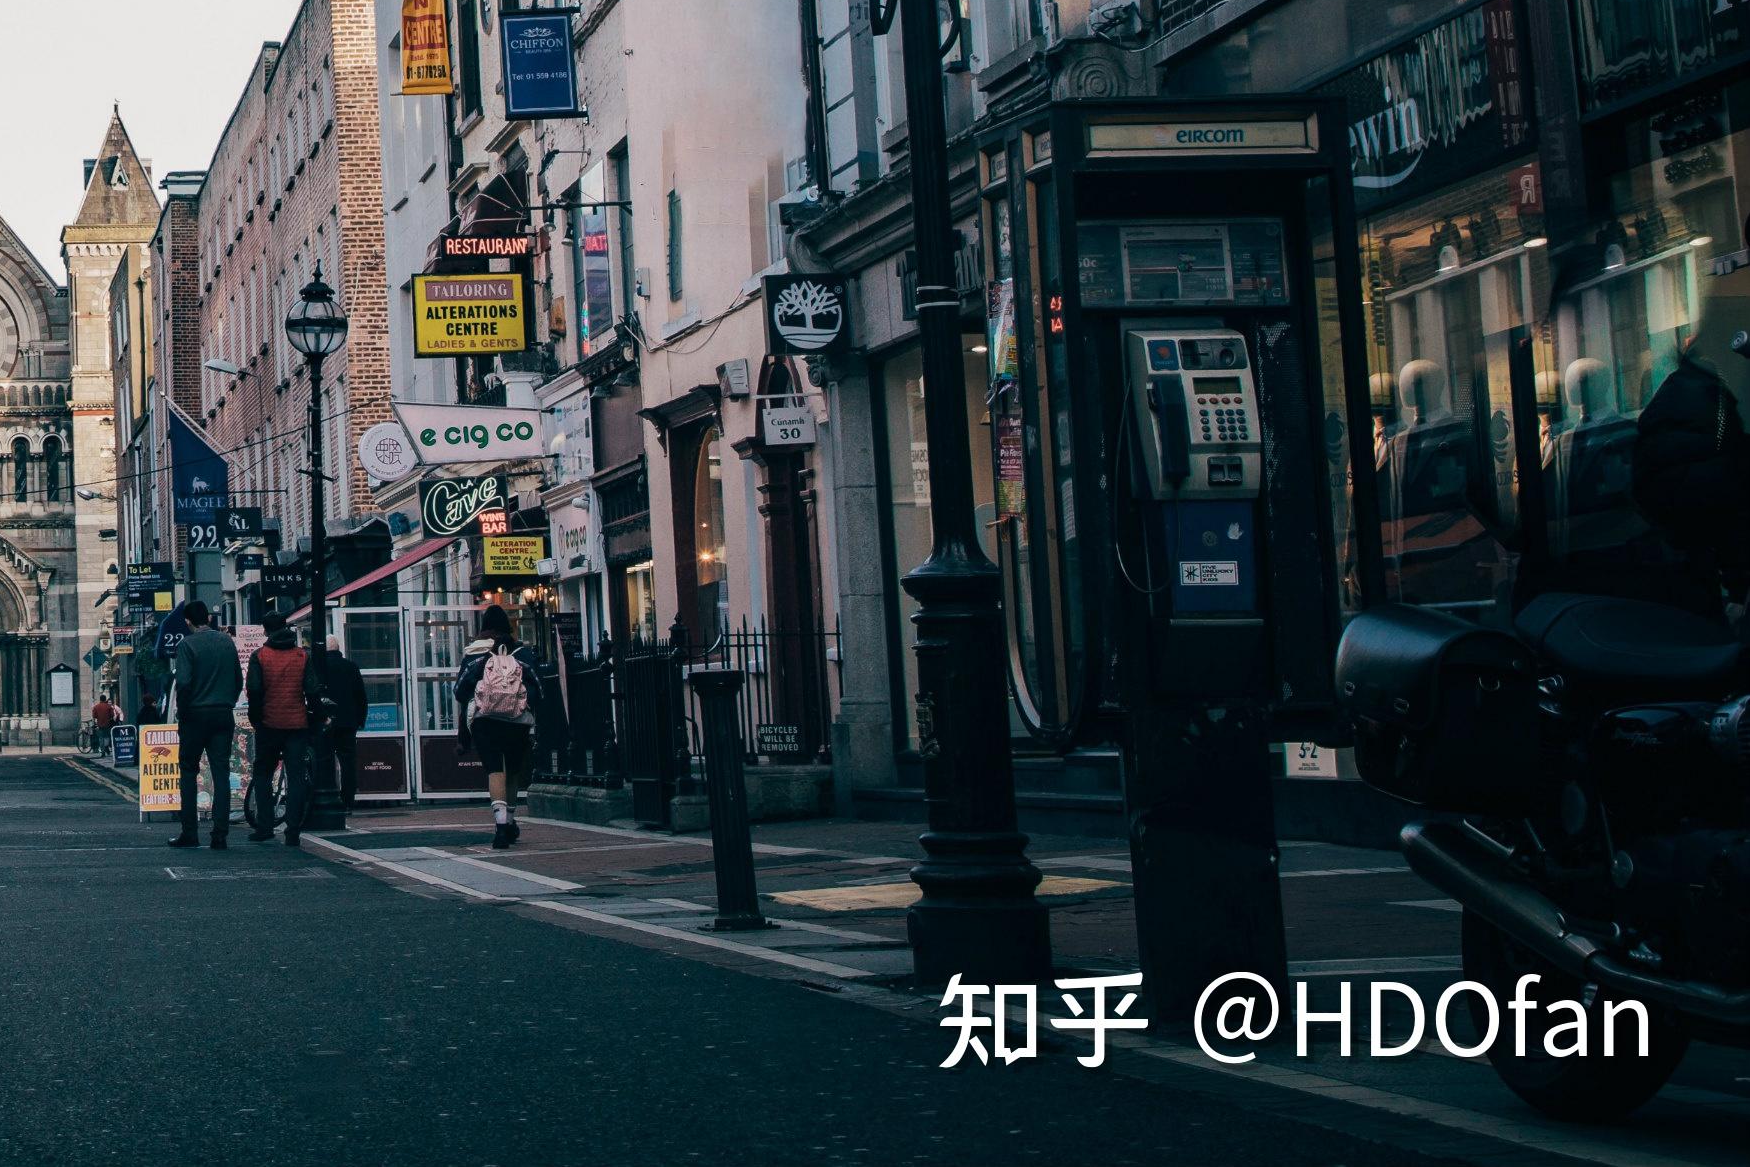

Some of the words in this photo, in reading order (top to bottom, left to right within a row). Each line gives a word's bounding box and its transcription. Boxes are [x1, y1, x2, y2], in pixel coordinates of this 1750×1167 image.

[405, 17, 444, 47] CENTRE
[510, 37, 563, 49] CHIFFON
[445, 237, 528, 255] RESTAURANT
[432, 283, 508, 298] TAILORING
[426, 304, 518, 320] ALTERATIONS
[445, 322, 499, 337] CENTRE
[427, 340, 466, 349] LADIES
[469, 340, 476, 348] &
[480, 338, 519, 349] GENTS
[420, 428, 437, 446] e
[444, 425, 489, 449] cig
[496, 421, 534, 442] co
[779, 427, 801, 440] 30
[460, 480, 474, 490] LA
[177, 496, 226, 509] MAGEE
[423, 477, 498, 535] Cave
[482, 523, 508, 534] BAR
[191, 525, 220, 549] 22
[490, 540, 537, 548] ALTERATION
[128, 565, 138, 574] To
[139, 565, 152, 574] Let
[264, 573, 302, 582] LINKS
[759, 726, 798, 734] BICYCLES
[763, 734, 784, 743] WILL
[785, 734, 796, 743] BE
[761, 743, 799, 752] REMOVED
[153, 777, 181, 791] CENTR
